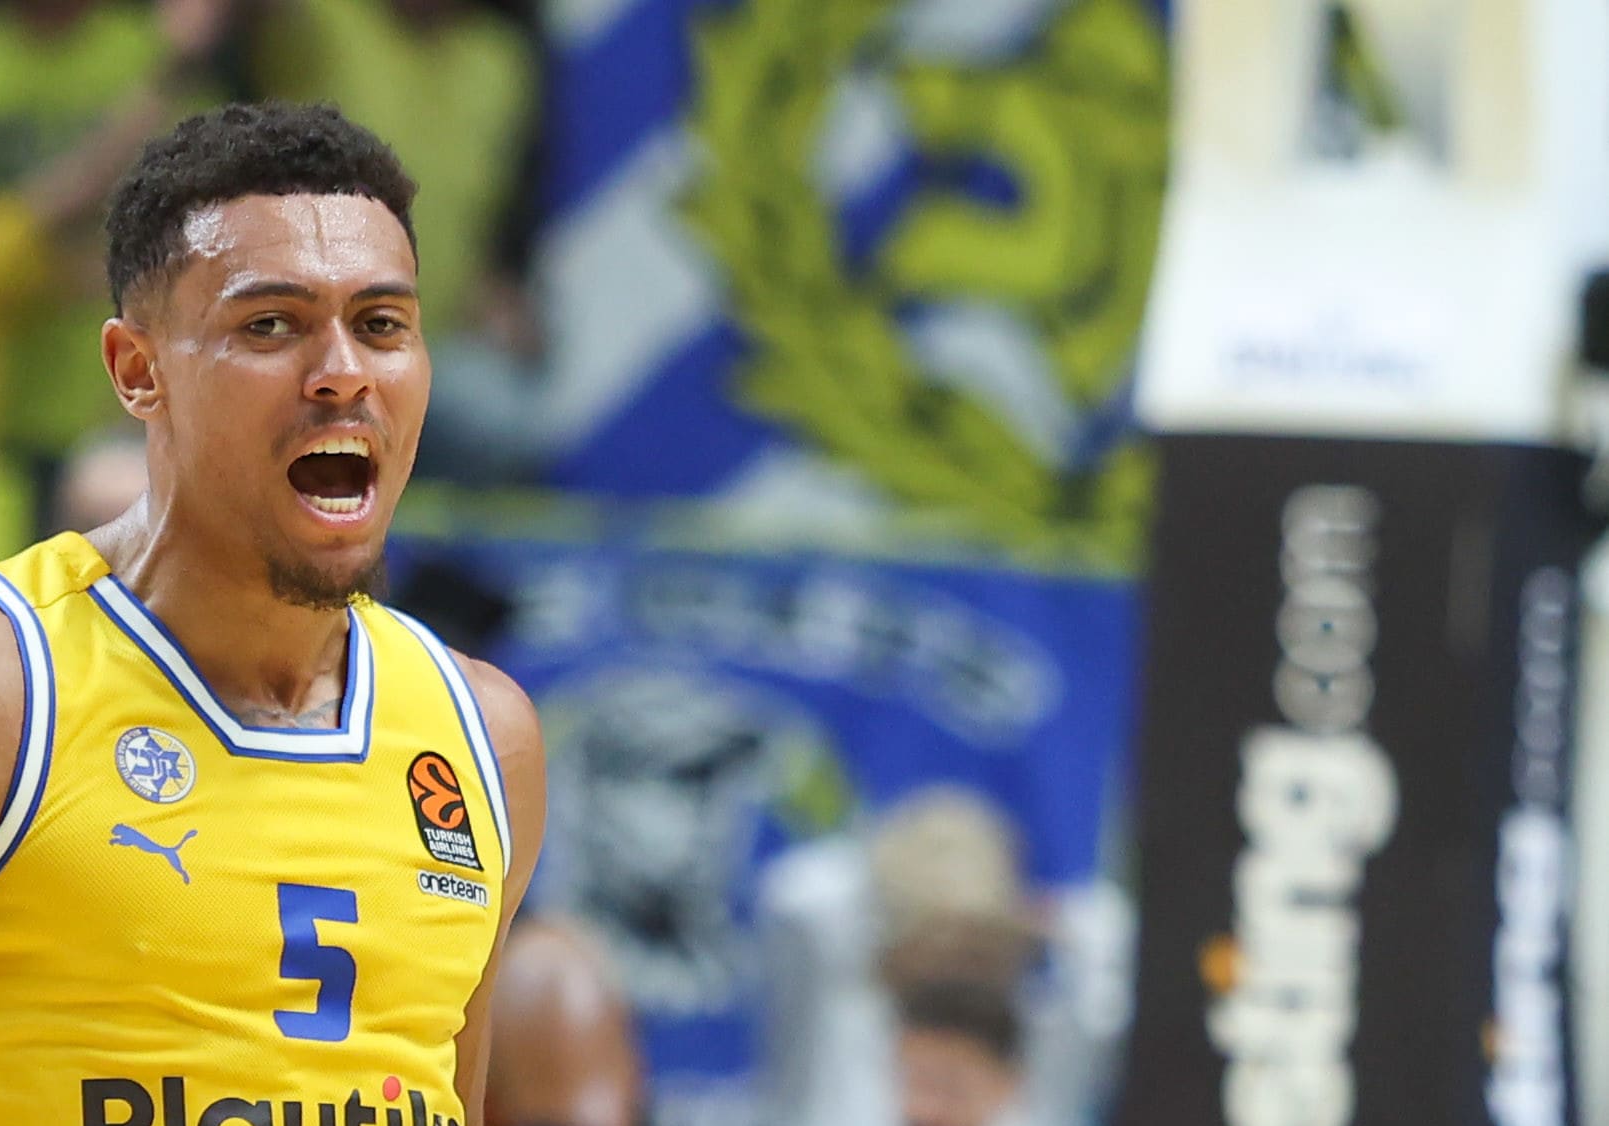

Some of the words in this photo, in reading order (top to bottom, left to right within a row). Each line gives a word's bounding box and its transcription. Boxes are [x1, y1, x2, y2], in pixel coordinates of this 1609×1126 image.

[424, 828, 472, 848] TURKISH
[429, 841, 475, 859] AIRLINES
[419, 873, 487, 904] oneteam
[273, 882, 359, 1042] 5
